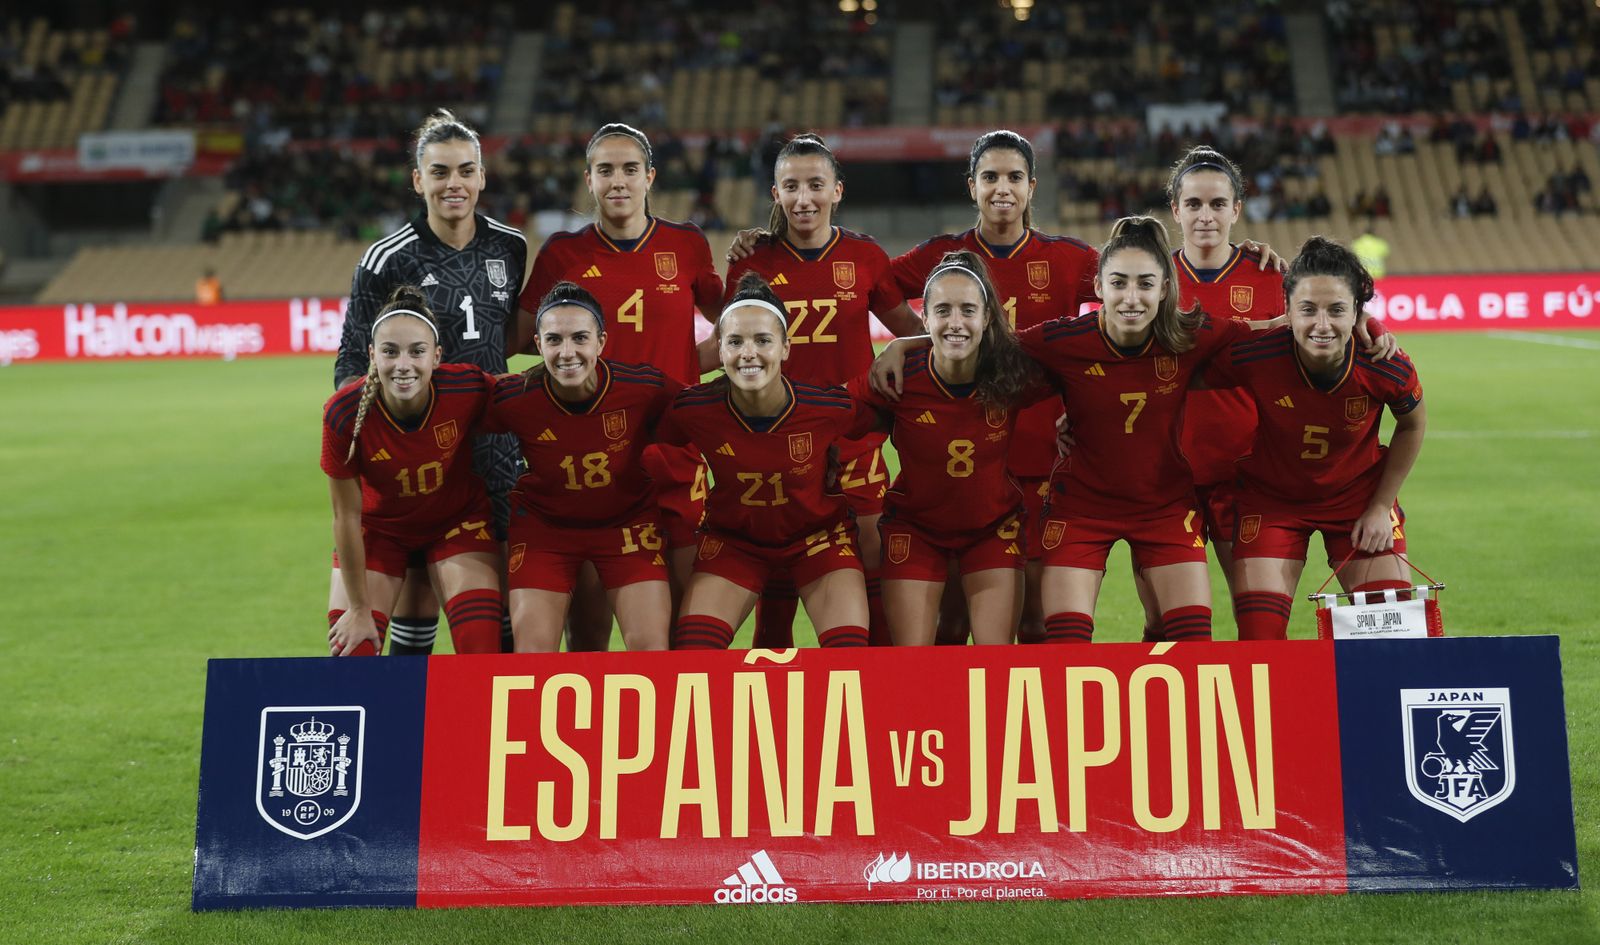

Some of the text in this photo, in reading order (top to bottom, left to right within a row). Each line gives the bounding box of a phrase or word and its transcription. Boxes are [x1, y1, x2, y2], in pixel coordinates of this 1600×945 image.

[459, 295, 480, 340] 1
[617, 289, 644, 332] 4
[1478, 292, 1530, 319] DE
[1543, 284, 1600, 318] FÚ
[783, 298, 838, 345] 22
[1119, 391, 1147, 434] 7
[946, 439, 976, 478] 8
[1300, 424, 1330, 460] 5
[394, 461, 444, 497] 10
[559, 451, 612, 490] 18
[736, 472, 789, 507] 21
[1356, 612, 1402, 628] SPAIN JAPAN
[1427, 692, 1484, 702] JAPAN
[486, 641, 1277, 842] ESPAÑA VS JAPÓN
[1434, 777, 1489, 800] JFA
[282, 808, 334, 817] 19 09
[917, 861, 1047, 880] IBERDROLA
[713, 883, 798, 904] adidas
[917, 886, 1047, 900] Por ti. Por el planeta.
